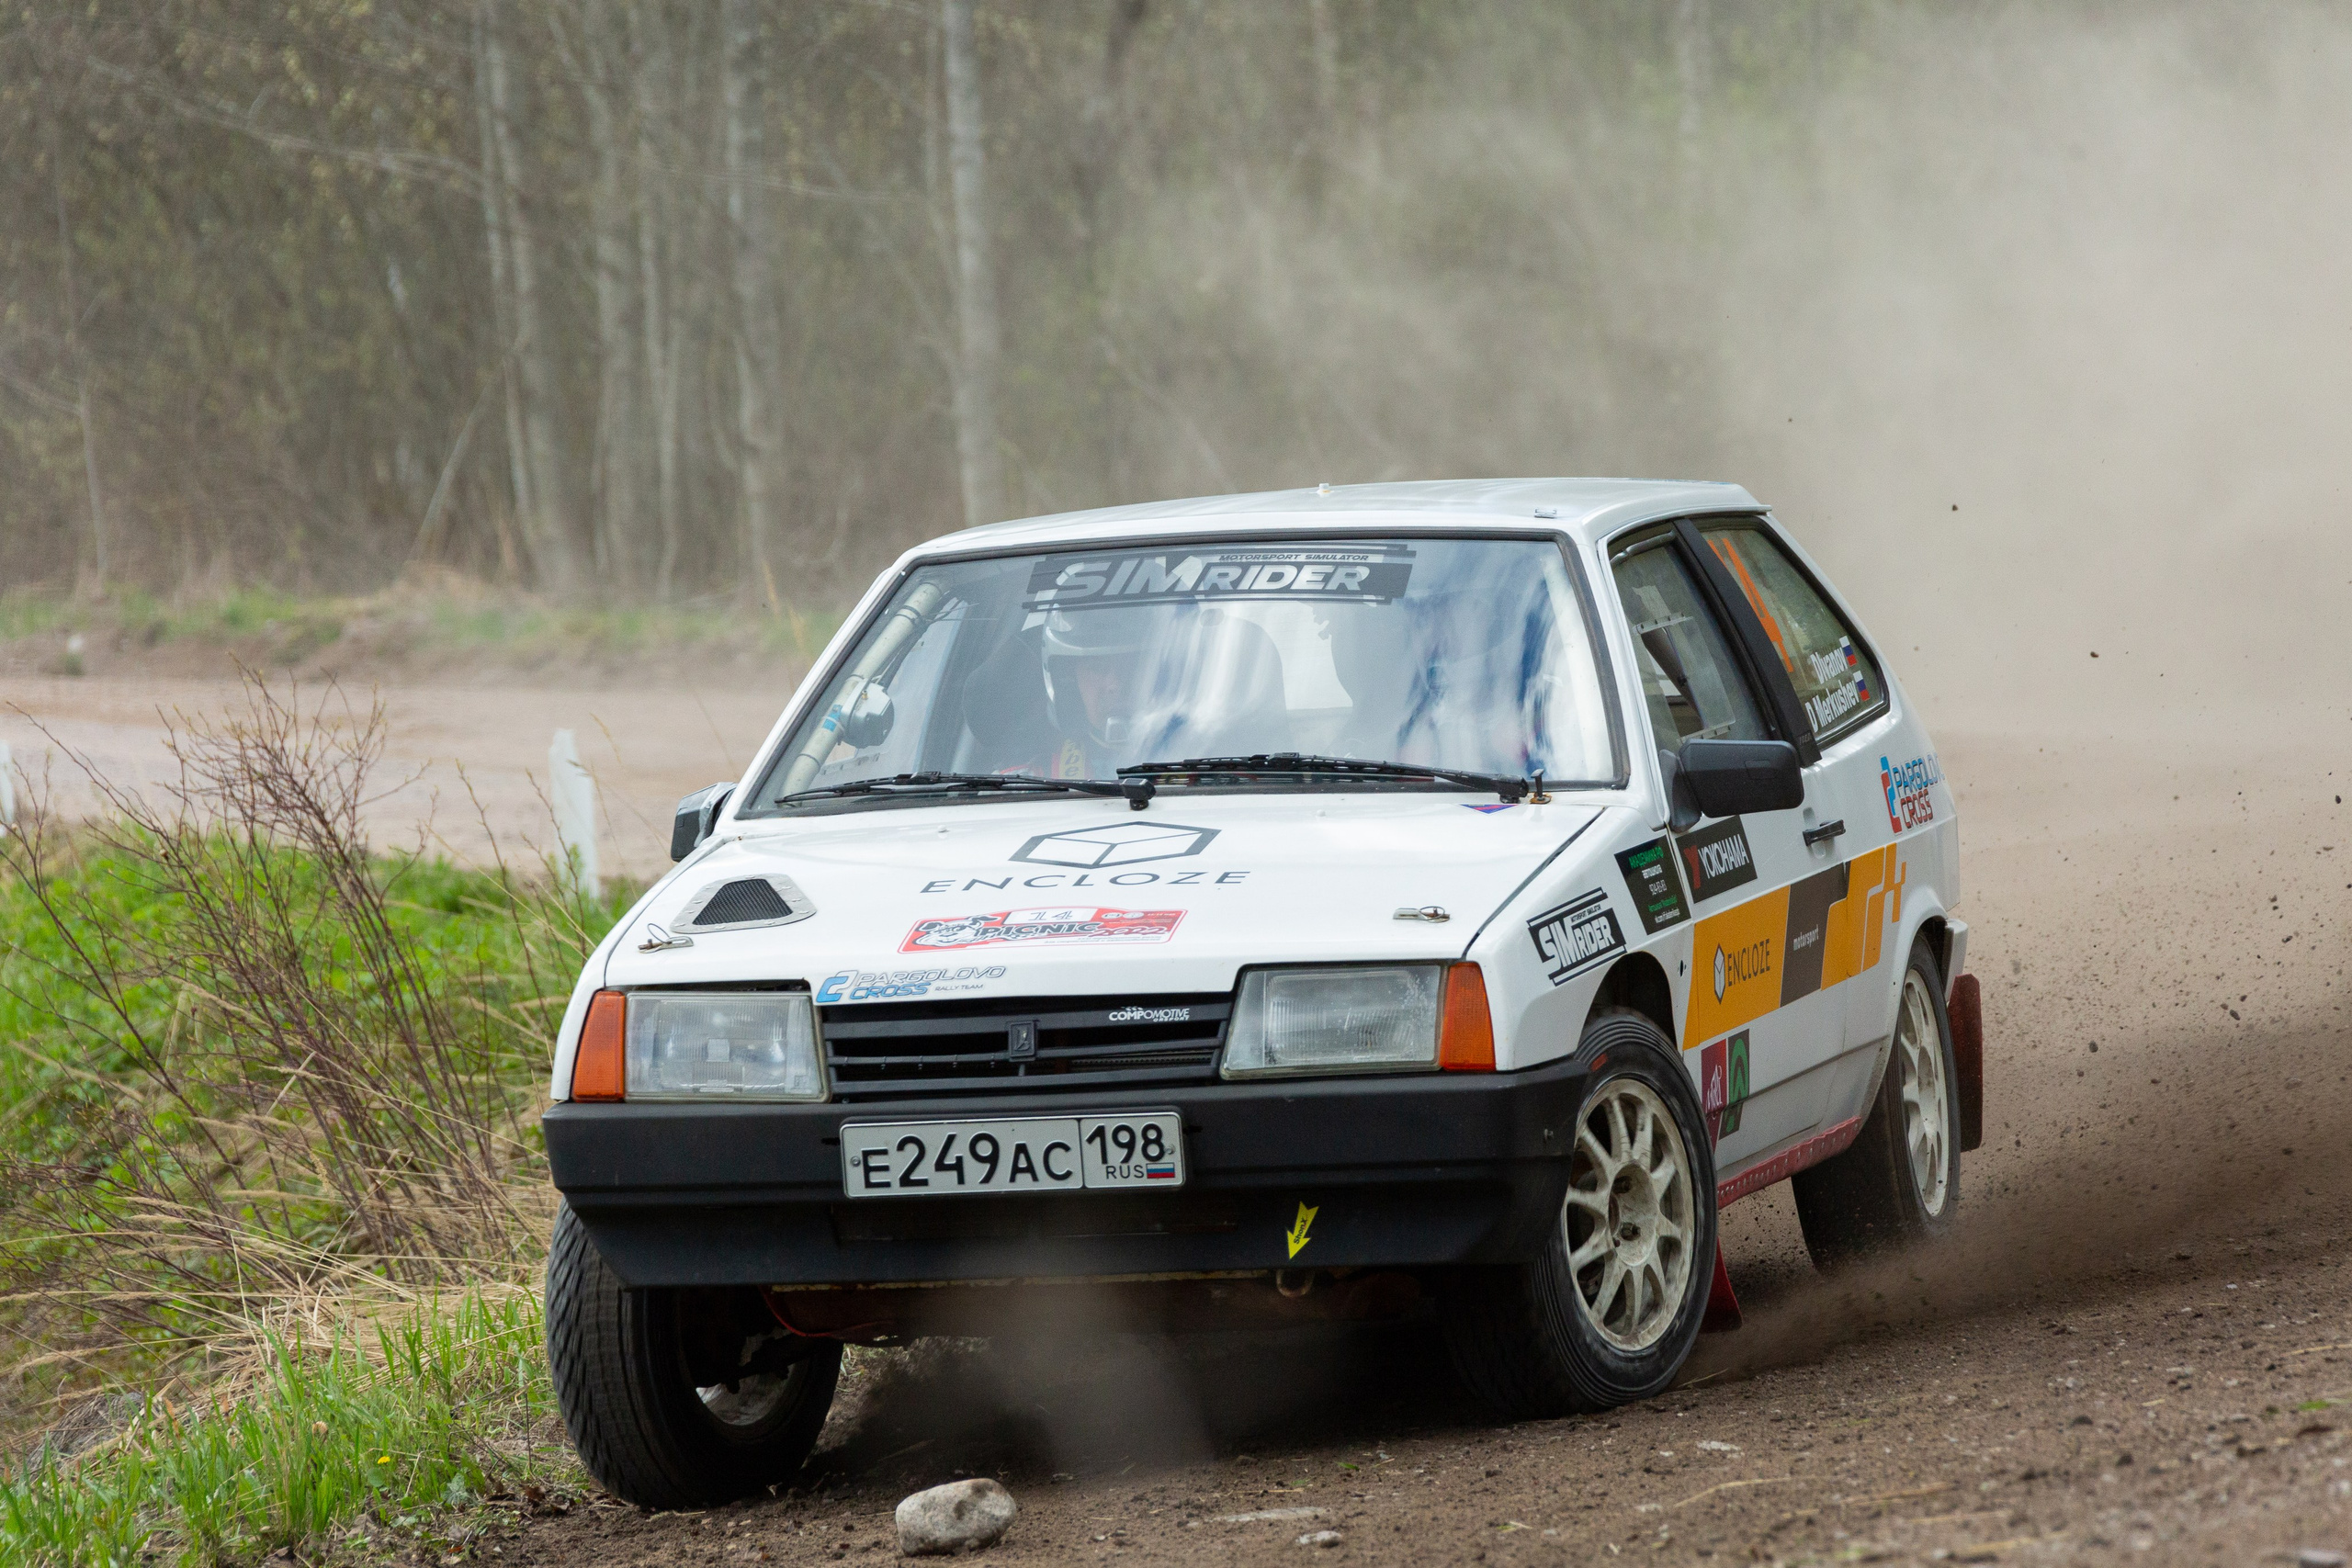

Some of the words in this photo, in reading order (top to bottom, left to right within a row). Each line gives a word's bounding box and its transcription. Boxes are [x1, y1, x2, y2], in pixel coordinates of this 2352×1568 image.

[1804, 701, 1819, 733] D
[1813, 679, 1860, 728] Merkushev
[1900, 788, 1934, 829] CROSS
[1697, 833, 1750, 879] YOKOHAMA
[920, 871, 1251, 894] ENCLOZE
[974, 921, 1102, 937] PICNIC
[1088, 925, 1168, 938] 2022
[1792, 924, 1819, 952] motorsport
[1727, 938, 1770, 987] ENCLOZE
[855, 965, 1007, 987] PARGOLOVO
[849, 981, 932, 1000] CROSS
[1108, 1008, 1191, 1021] COMPOMOTIVE
[1085, 1123, 1166, 1165] 198
[1105, 1165, 1145, 1180] RUS
